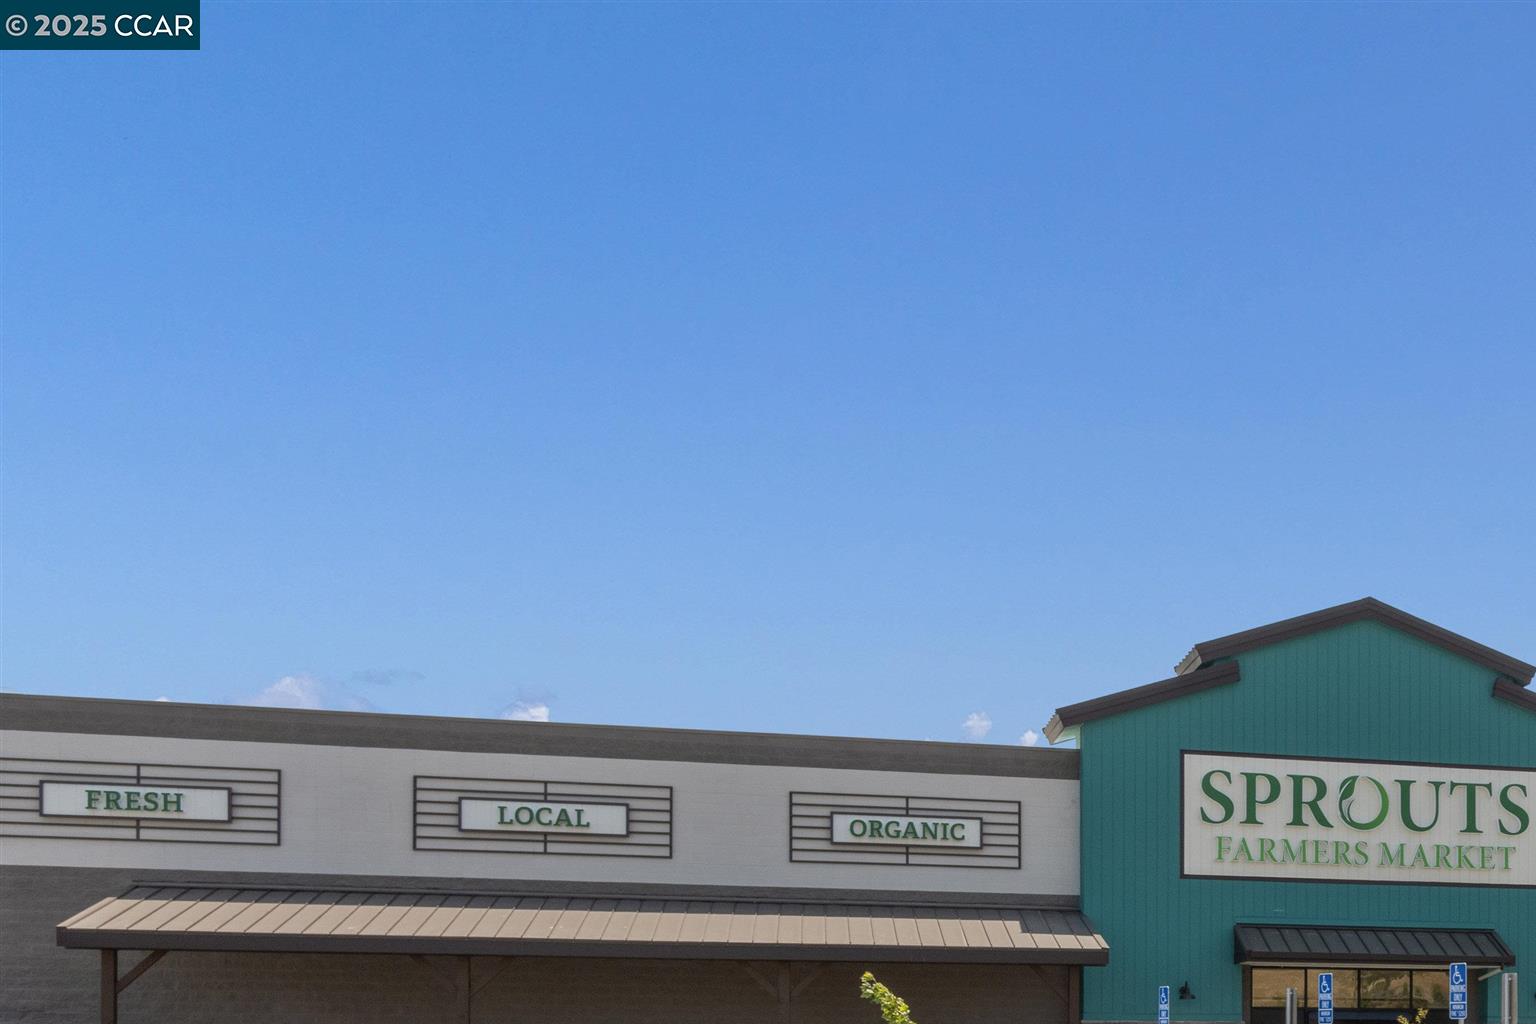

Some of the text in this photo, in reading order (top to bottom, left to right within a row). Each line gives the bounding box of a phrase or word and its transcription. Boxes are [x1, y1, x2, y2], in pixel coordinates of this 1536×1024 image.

[84, 789, 184, 813] FRESH
[1199, 769, 1530, 836] SPROUTS
[497, 805, 590, 828] LOCAL
[849, 819, 966, 841] ORGANIC
[1215, 835, 1516, 871] FARMERS MARKET
